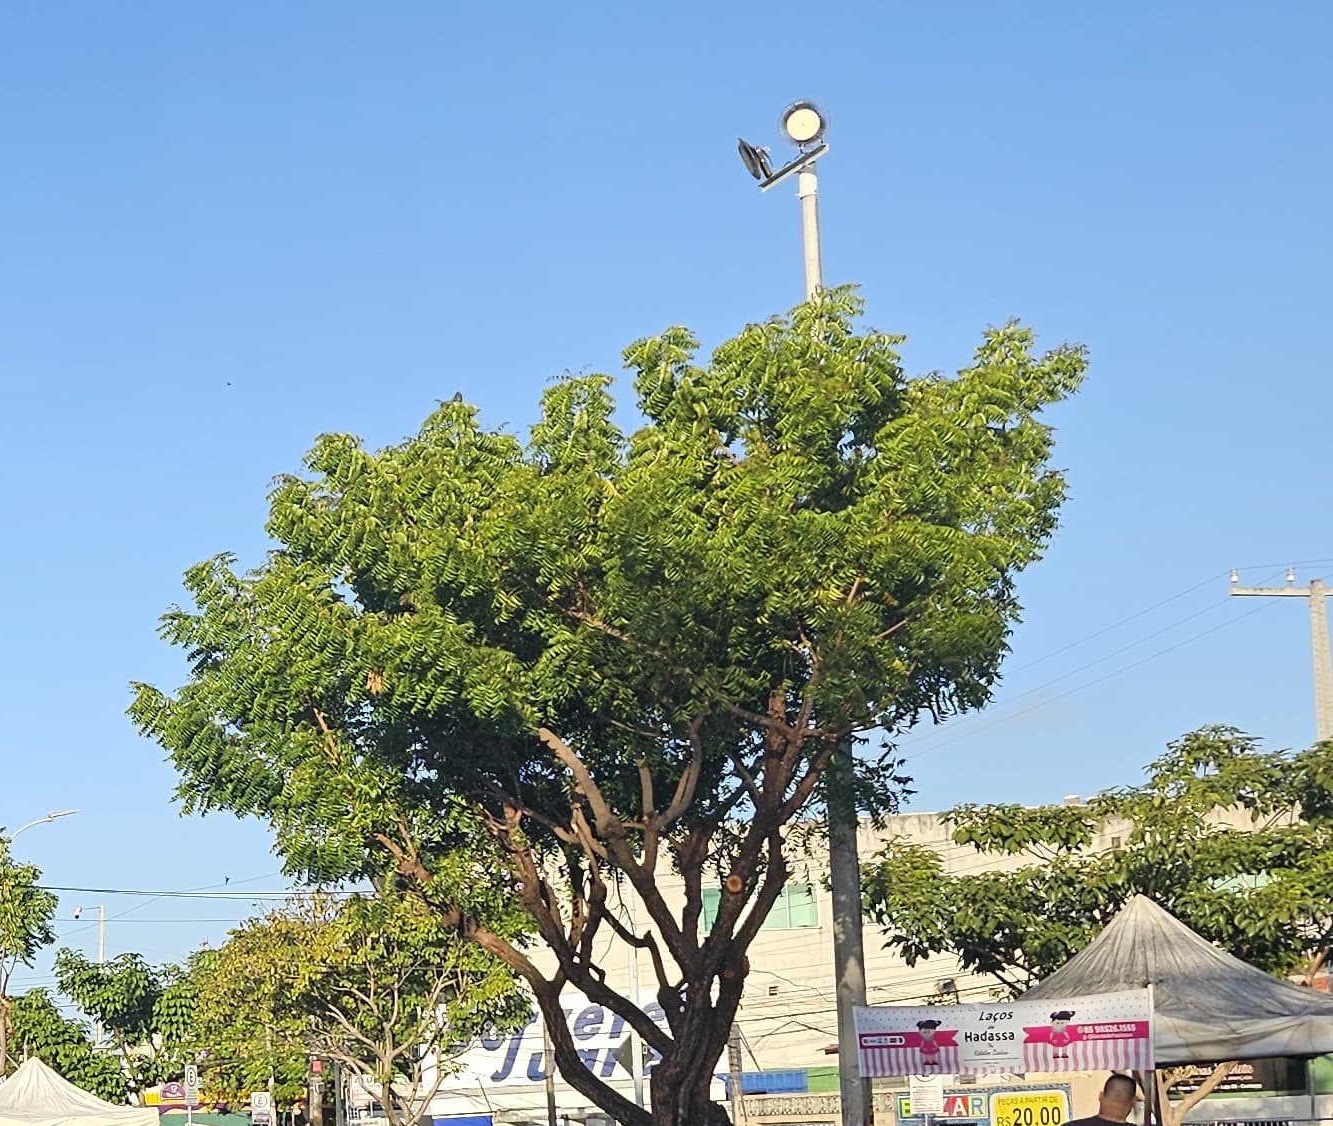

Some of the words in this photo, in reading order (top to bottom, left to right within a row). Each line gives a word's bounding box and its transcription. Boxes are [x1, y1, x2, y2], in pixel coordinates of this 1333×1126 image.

[979, 1011, 1013, 1022] Laços
[964, 1030, 1015, 1042] Hadassa
[997, 1098, 1018, 1106] PEÇAS
[1025, 1096, 1048, 1104] PARTIR
[900, 1097, 984, 1118] BAR
